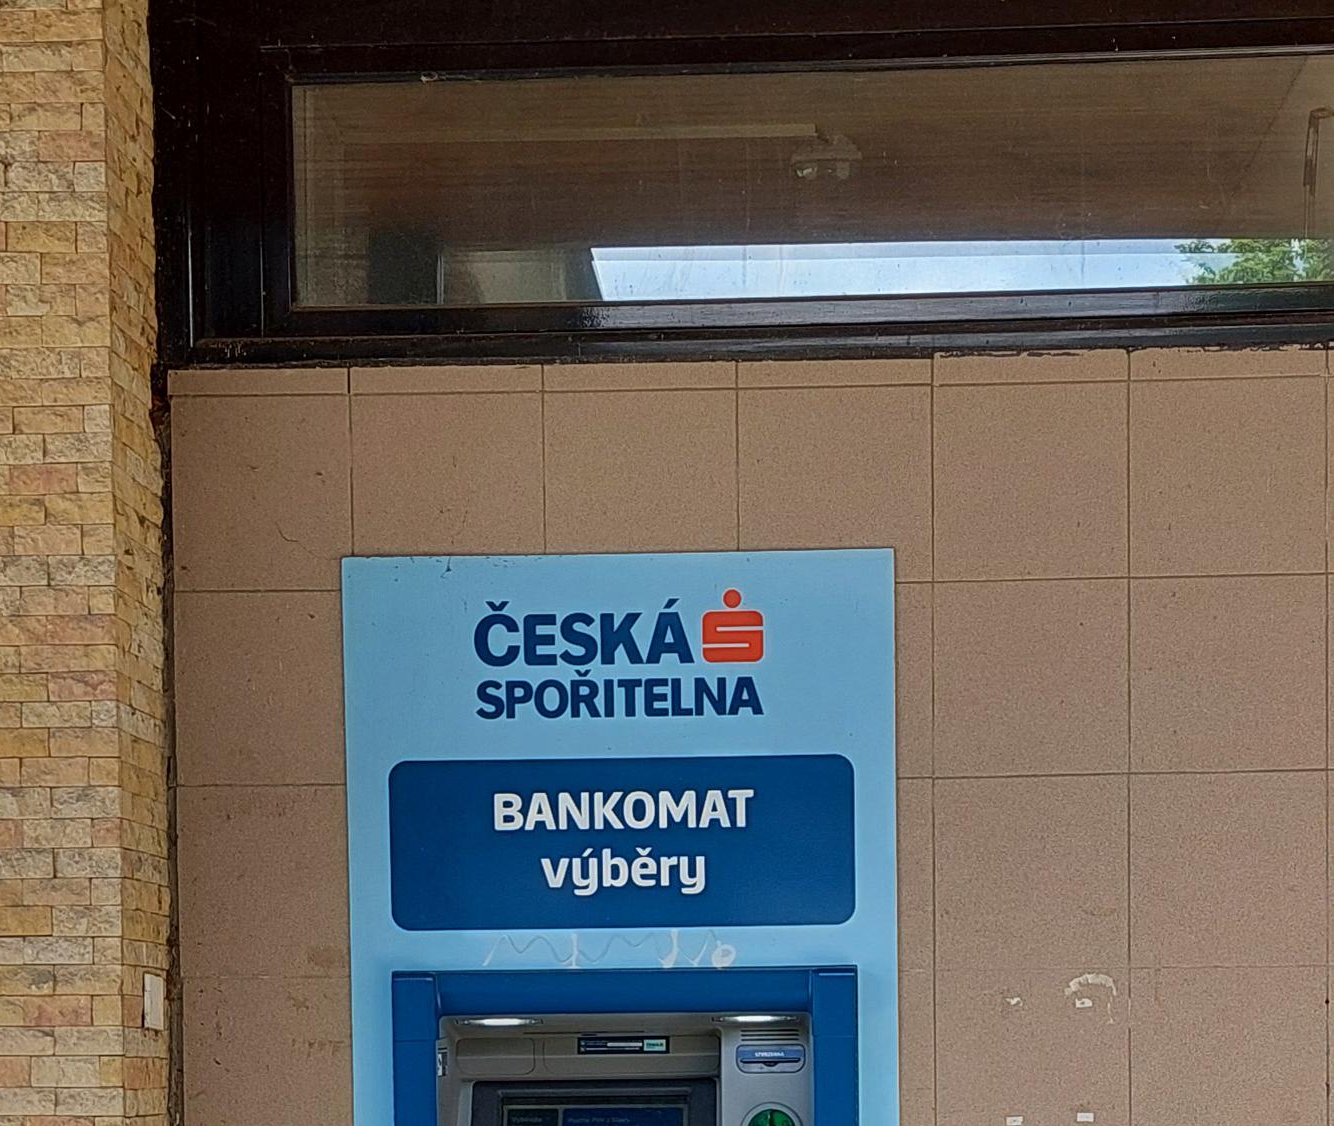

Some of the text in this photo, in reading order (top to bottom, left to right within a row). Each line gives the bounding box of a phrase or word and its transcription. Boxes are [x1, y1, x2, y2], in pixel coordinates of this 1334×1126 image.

[474, 598, 695, 666] ČESKÁ
[476, 669, 764, 719] SPOŘITELNA
[494, 789, 755, 831] BANKOMAT
[541, 847, 706, 896] výběry
